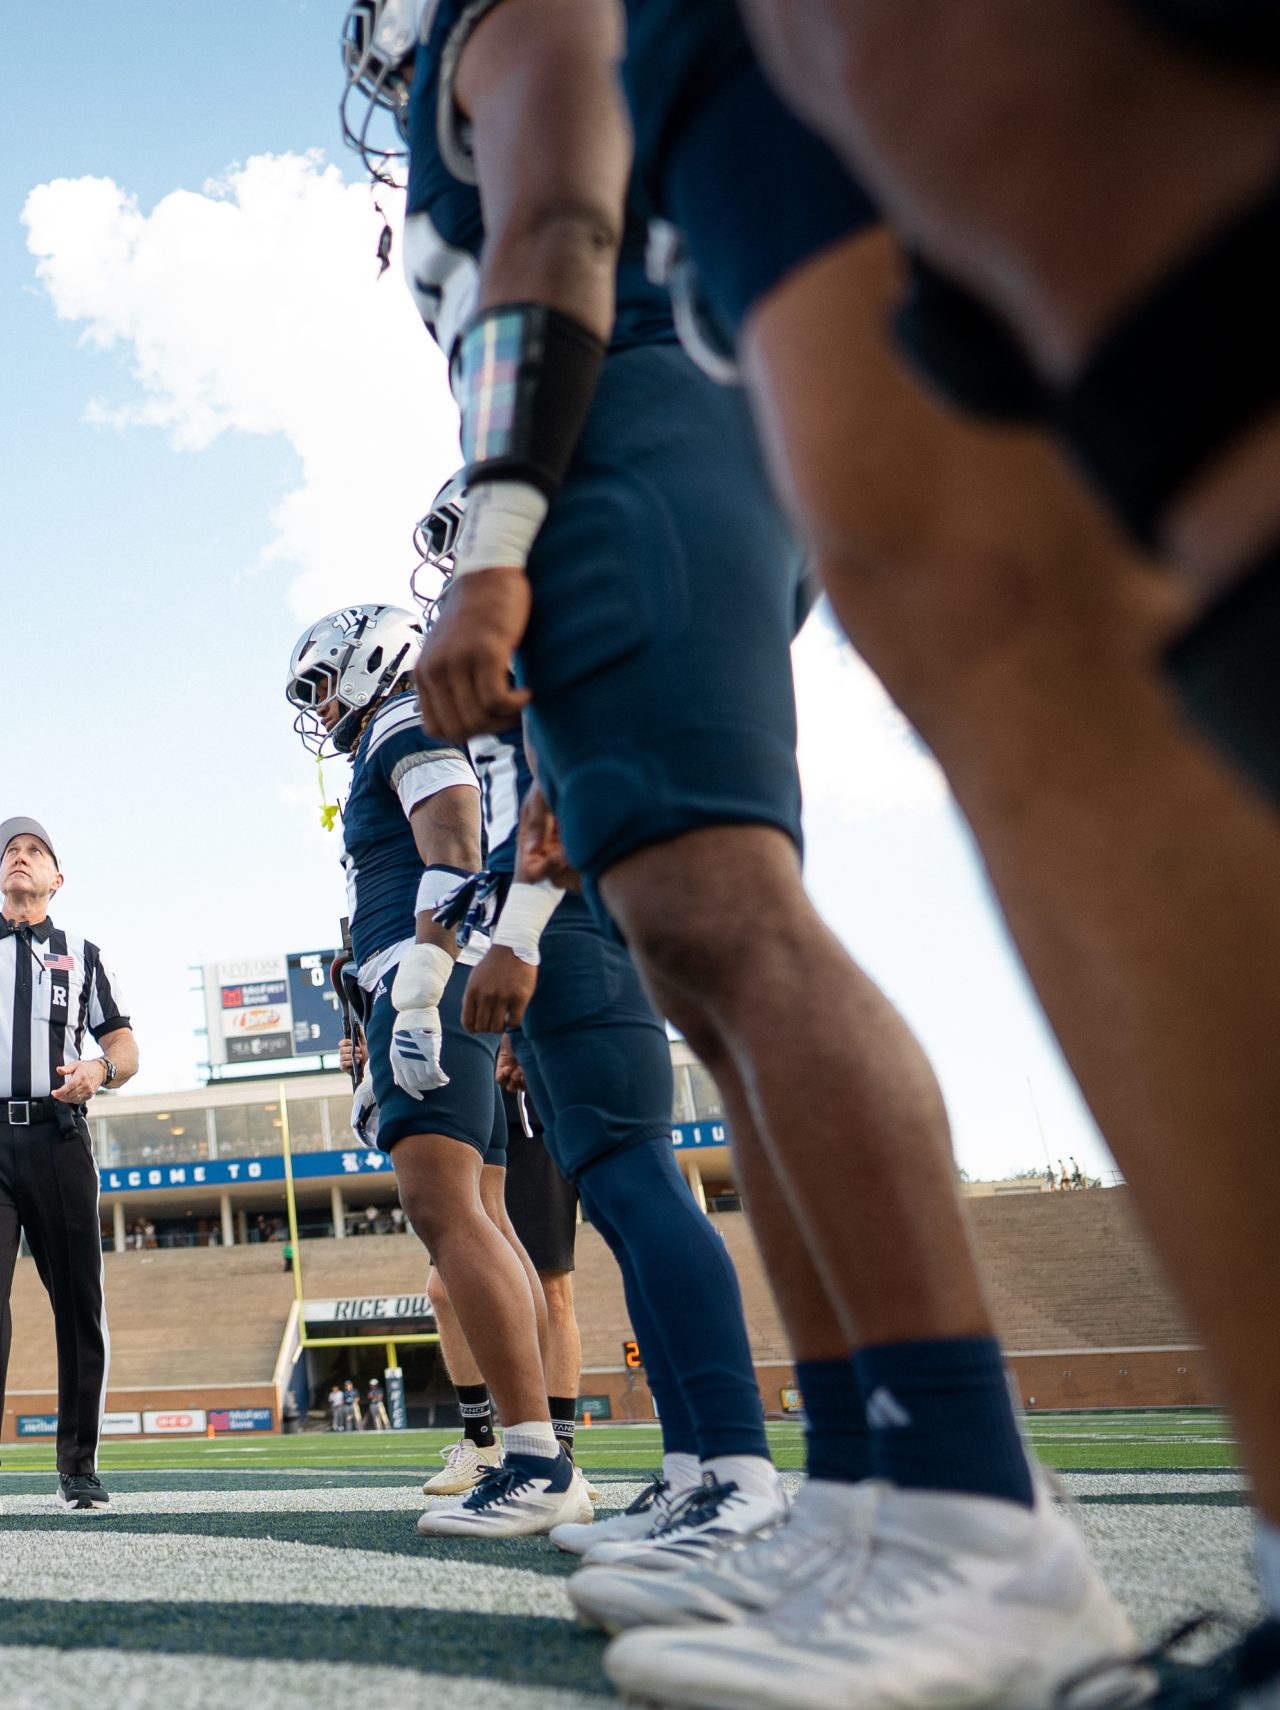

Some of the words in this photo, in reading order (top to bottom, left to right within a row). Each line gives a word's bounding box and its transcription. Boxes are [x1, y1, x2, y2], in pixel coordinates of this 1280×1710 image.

[311, 968, 325, 986] 0
[52, 985, 67, 1007] R
[99, 1166, 206, 1188] LCOME
[228, 1162, 262, 1178] TO
[334, 1299, 387, 1320] RICE
[395, 1296, 432, 1316] OW
